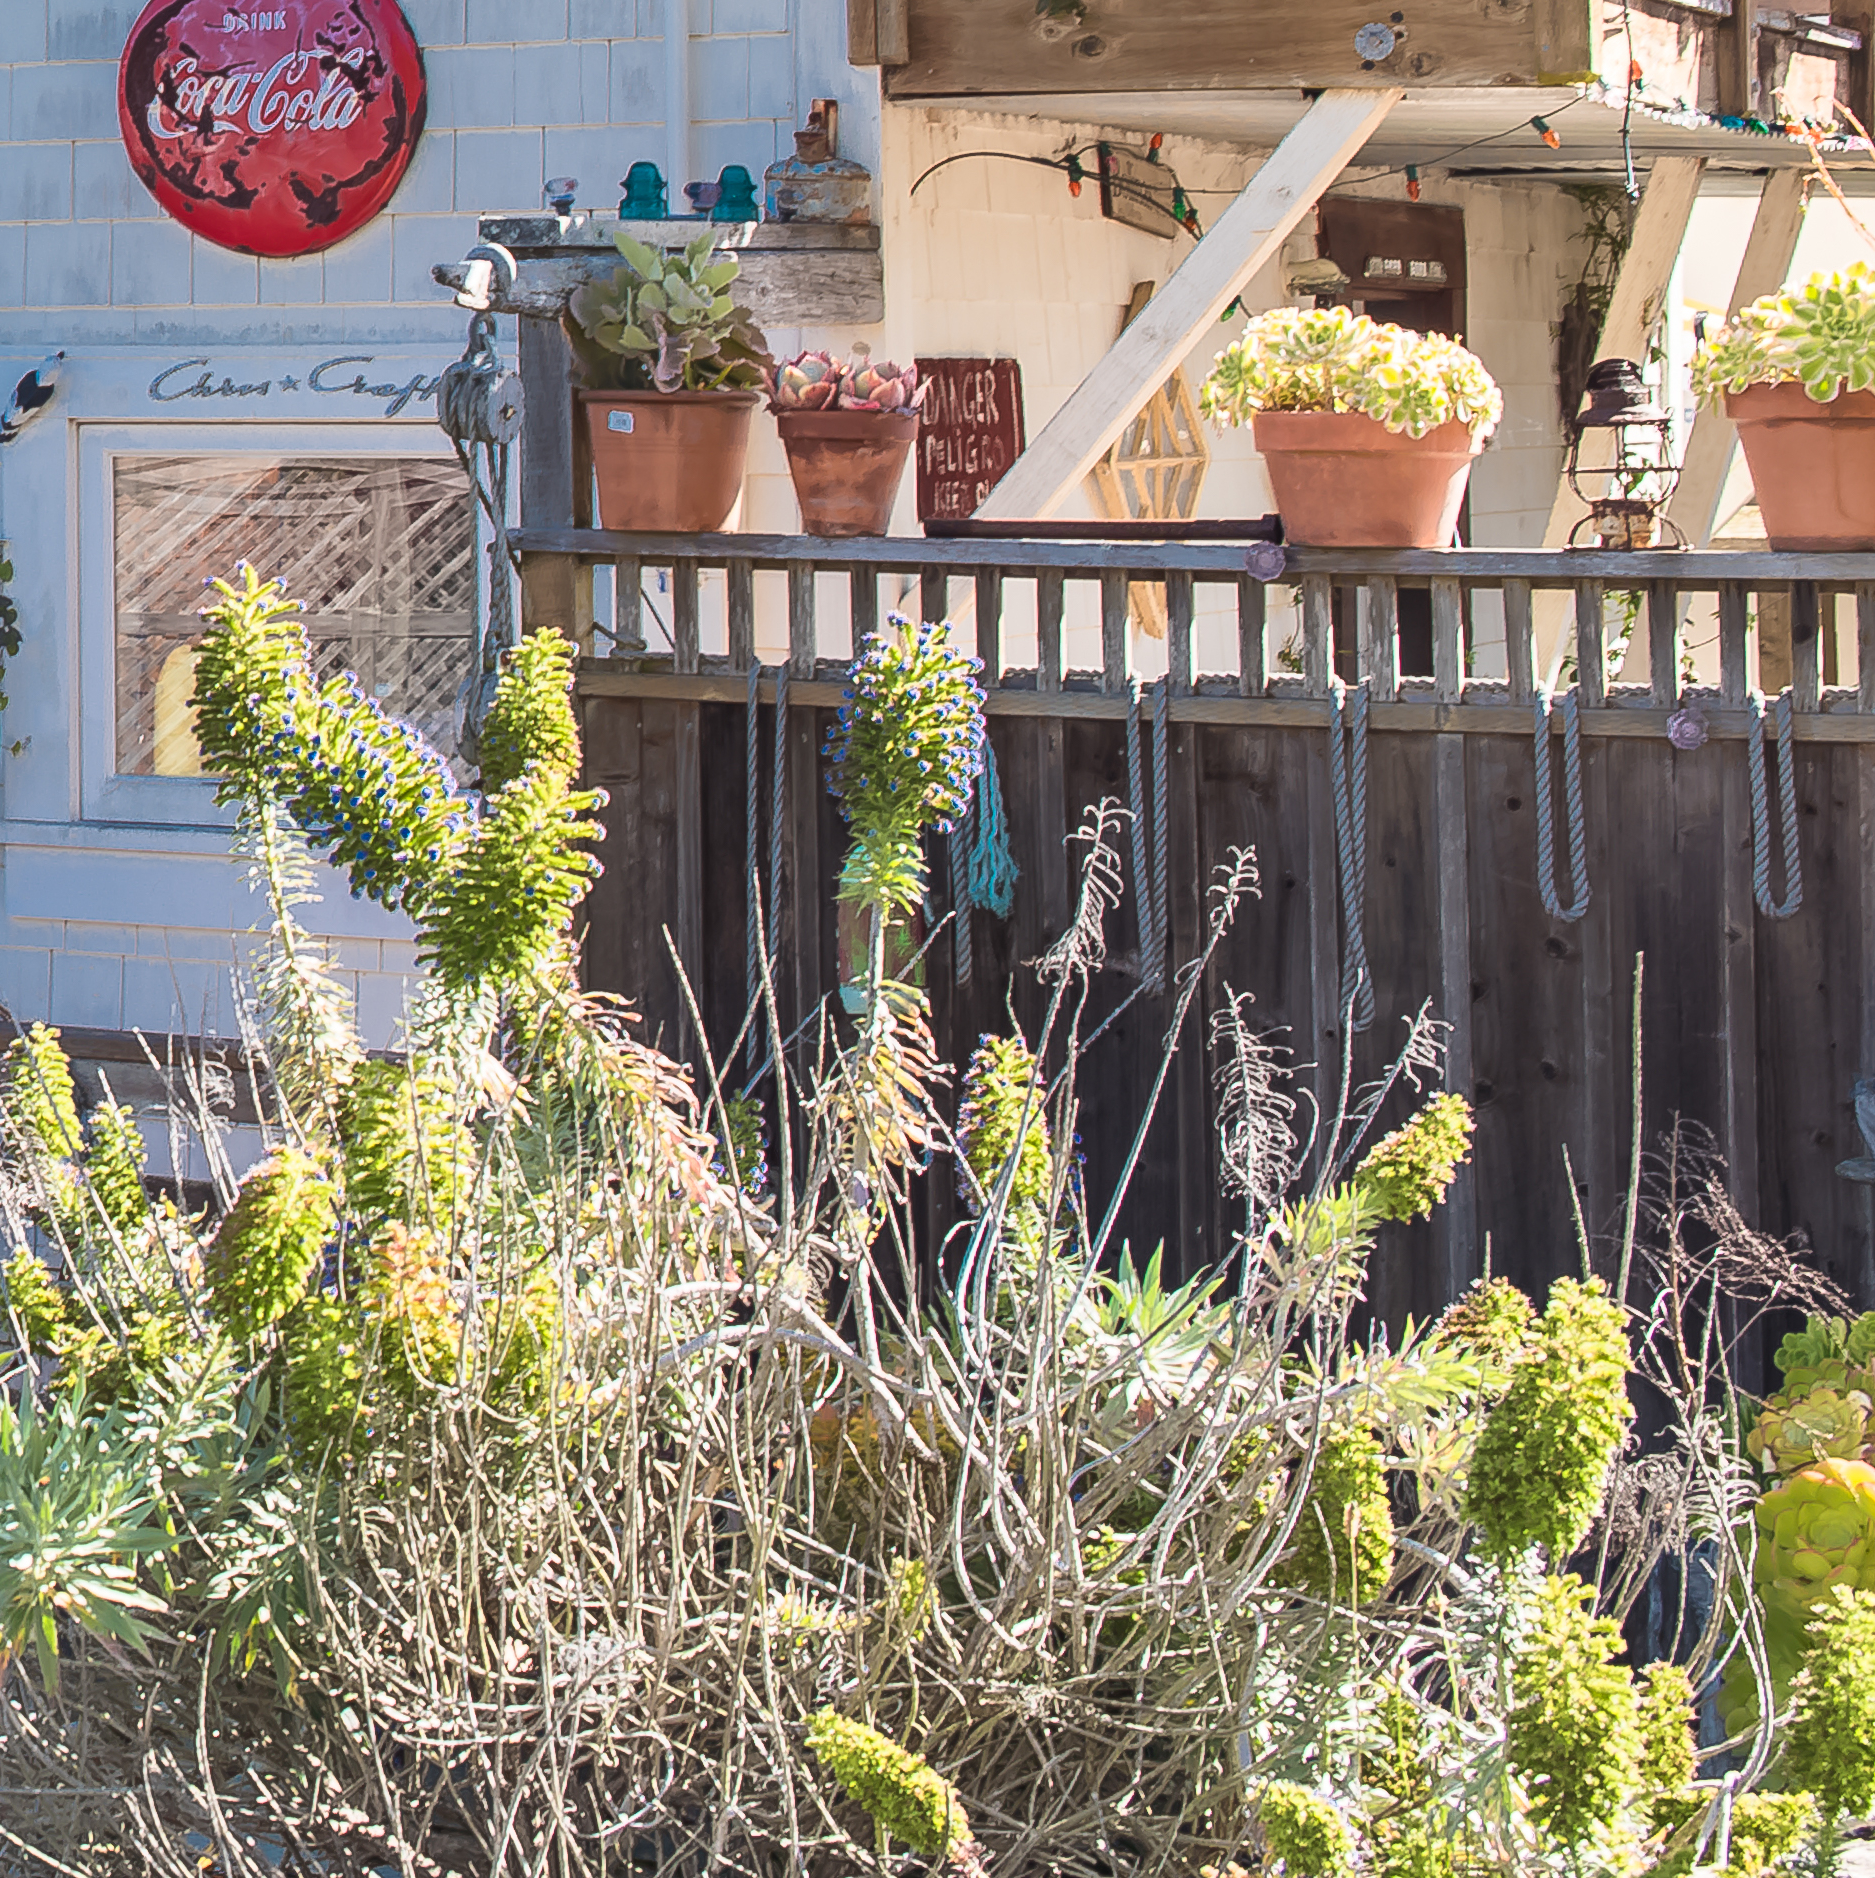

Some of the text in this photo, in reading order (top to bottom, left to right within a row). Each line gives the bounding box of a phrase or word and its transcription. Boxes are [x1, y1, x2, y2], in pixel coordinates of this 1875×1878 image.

[223, 10, 287, 34] DRINK
[147, 47, 371, 139] Coca-Cola
[147, 357, 271, 402] Chris
